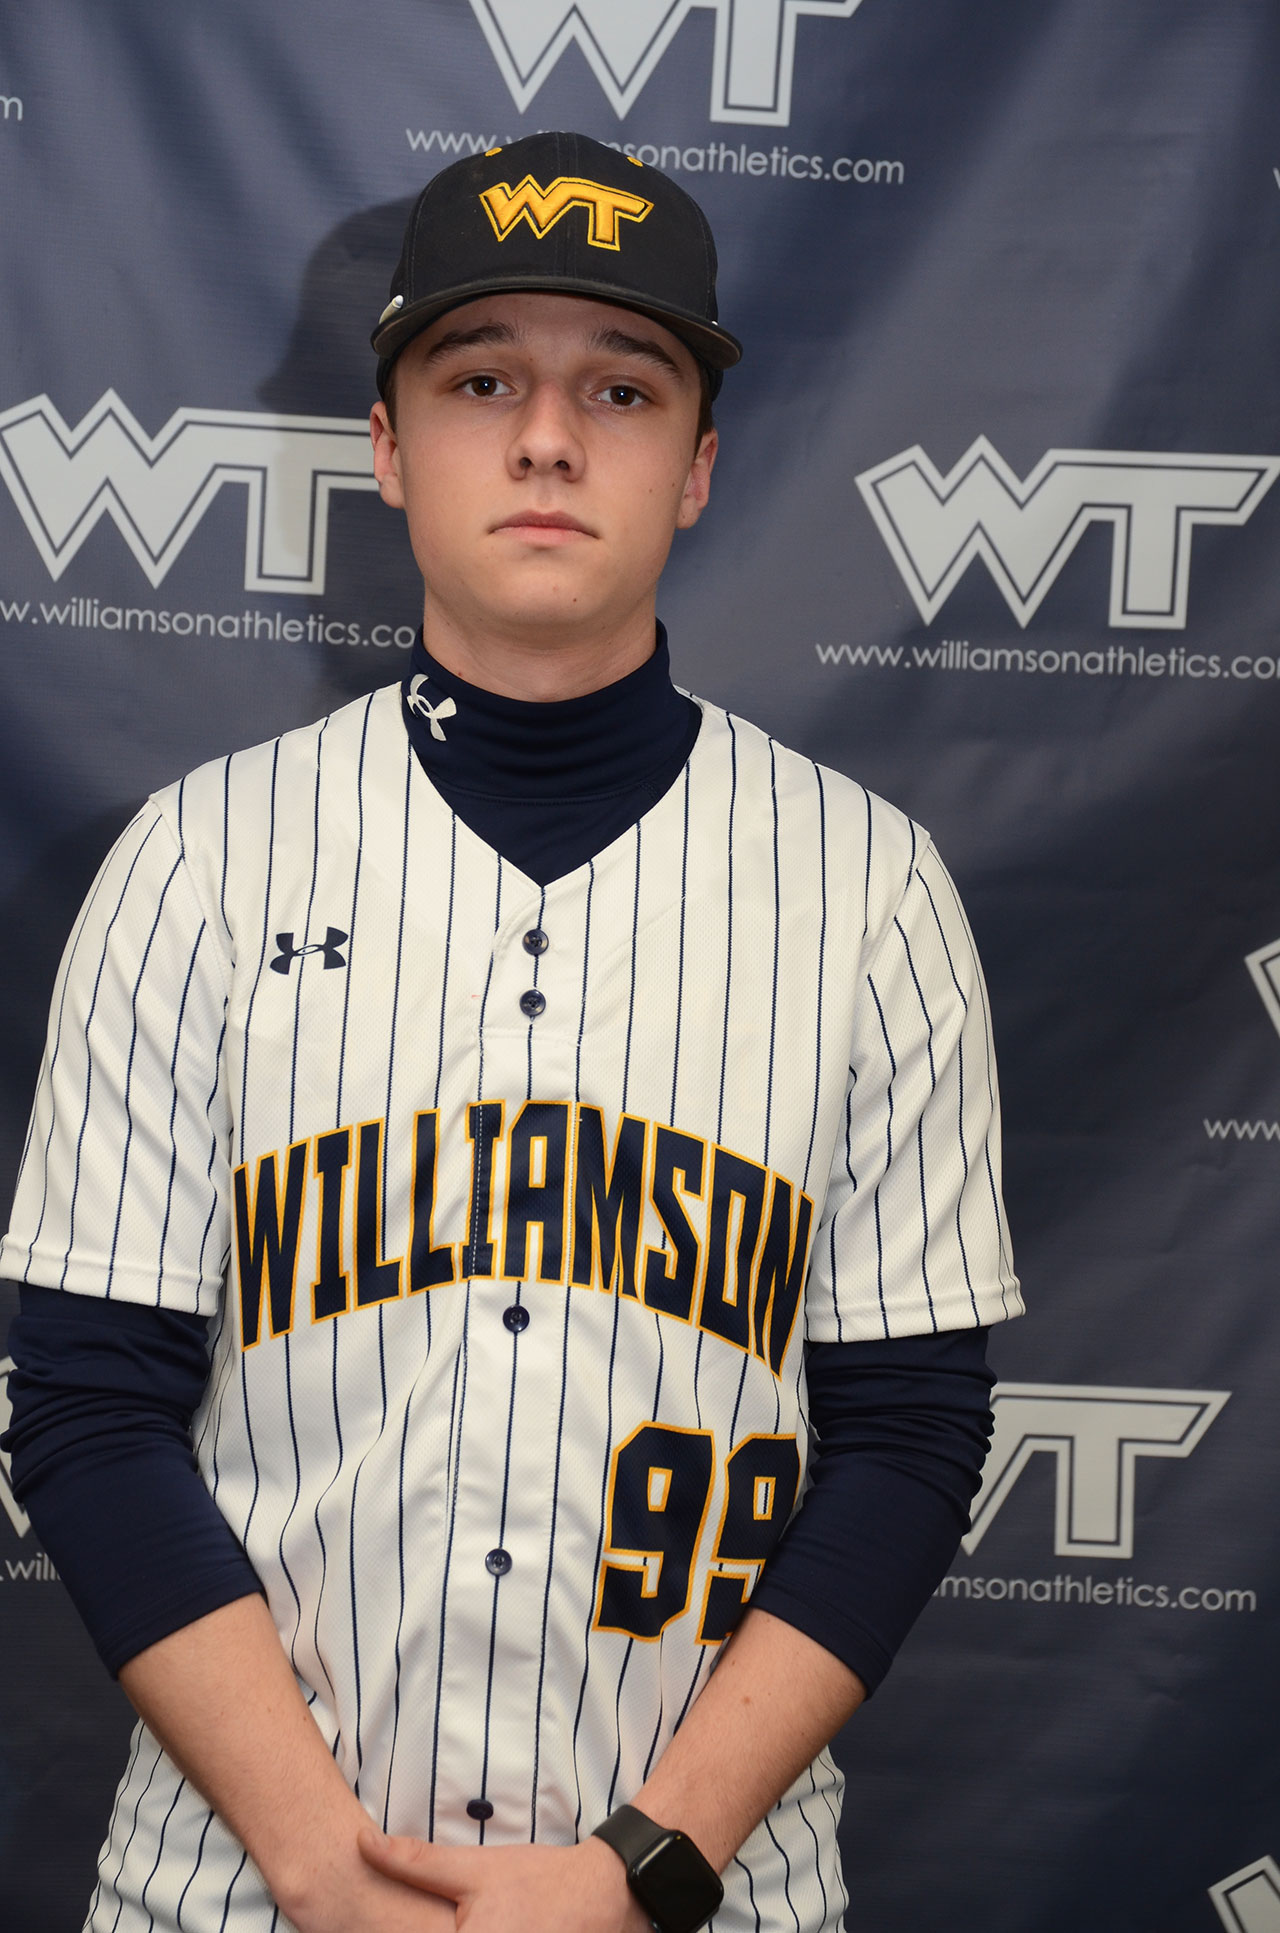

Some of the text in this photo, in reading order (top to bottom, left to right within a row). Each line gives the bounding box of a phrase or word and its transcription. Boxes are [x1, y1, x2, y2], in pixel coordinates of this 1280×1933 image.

[478, 174, 655, 251] WT
[0, 387, 381, 595] WT
[854, 434, 1280, 629] WT
[815, 640, 1280, 680] www.williamsonathletics.co
[233, 1099, 815, 1383] WILLIAMSON
[592, 1420, 801, 1646] 99
[932, 1575, 1257, 1612] msonathletics.com
